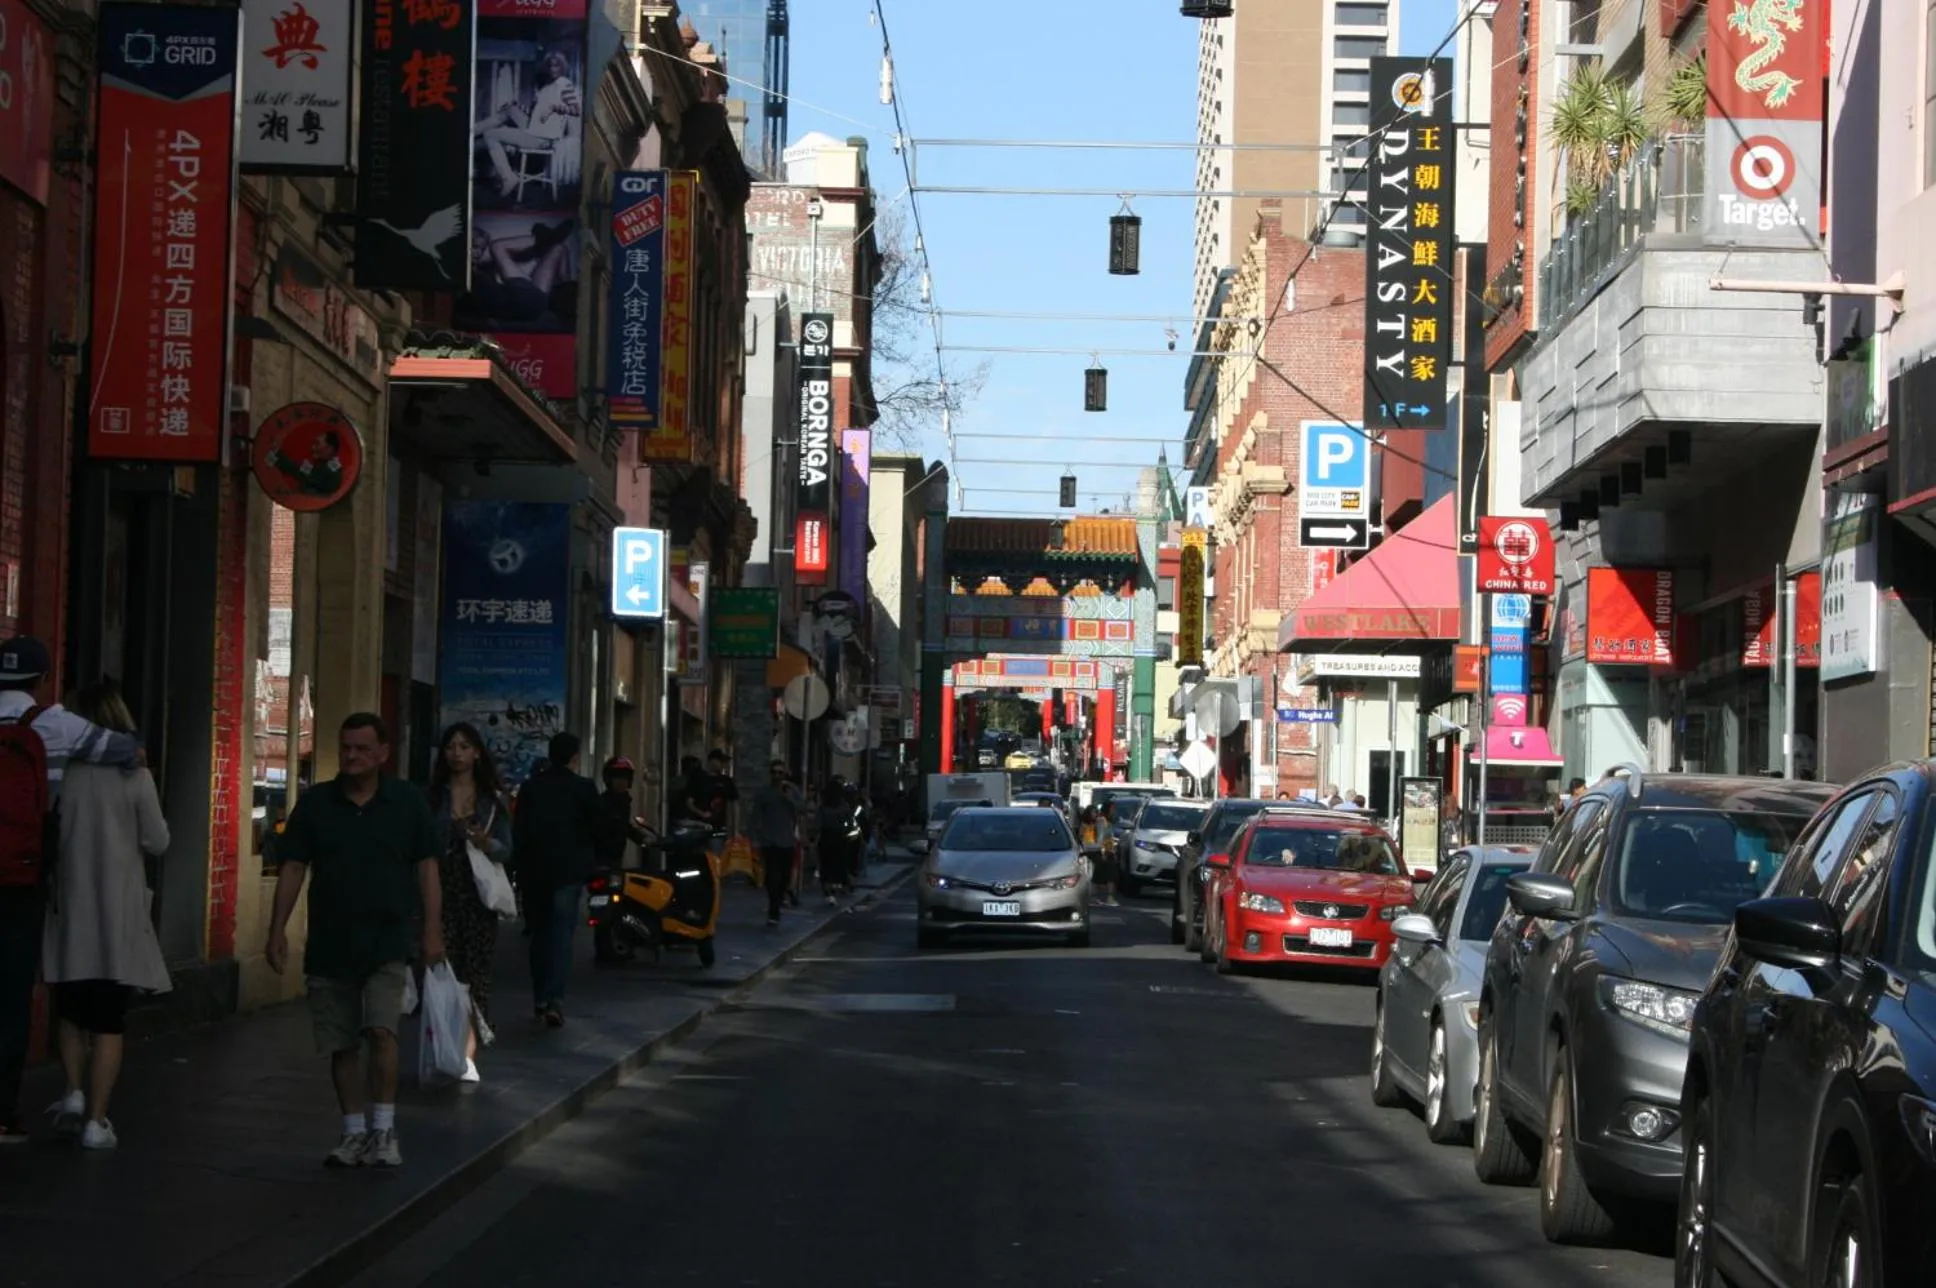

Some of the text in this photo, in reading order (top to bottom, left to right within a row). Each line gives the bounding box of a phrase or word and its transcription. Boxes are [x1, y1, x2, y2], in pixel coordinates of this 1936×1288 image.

[164, 46, 216, 64] GRID
[1377, 129, 1410, 378] DYNASTY
[1410, 127, 1441, 382] 王朝海鮮大酒家
[159, 130, 201, 436] 4PX递四方国际快递
[806, 380, 830, 486] BORNGA
[1318, 433, 1354, 480] P
[625, 540, 652, 574] P
[1485, 580, 1547, 590] CHINA RED
[456, 598, 553, 624] 环宇速递
[1304, 613, 1431, 632] WESTLAKE
[1654, 571, 1673, 664] DRAGON BOAT
[1322, 662, 1375, 671] TREASURES
[1377, 663, 1396, 672] AND
